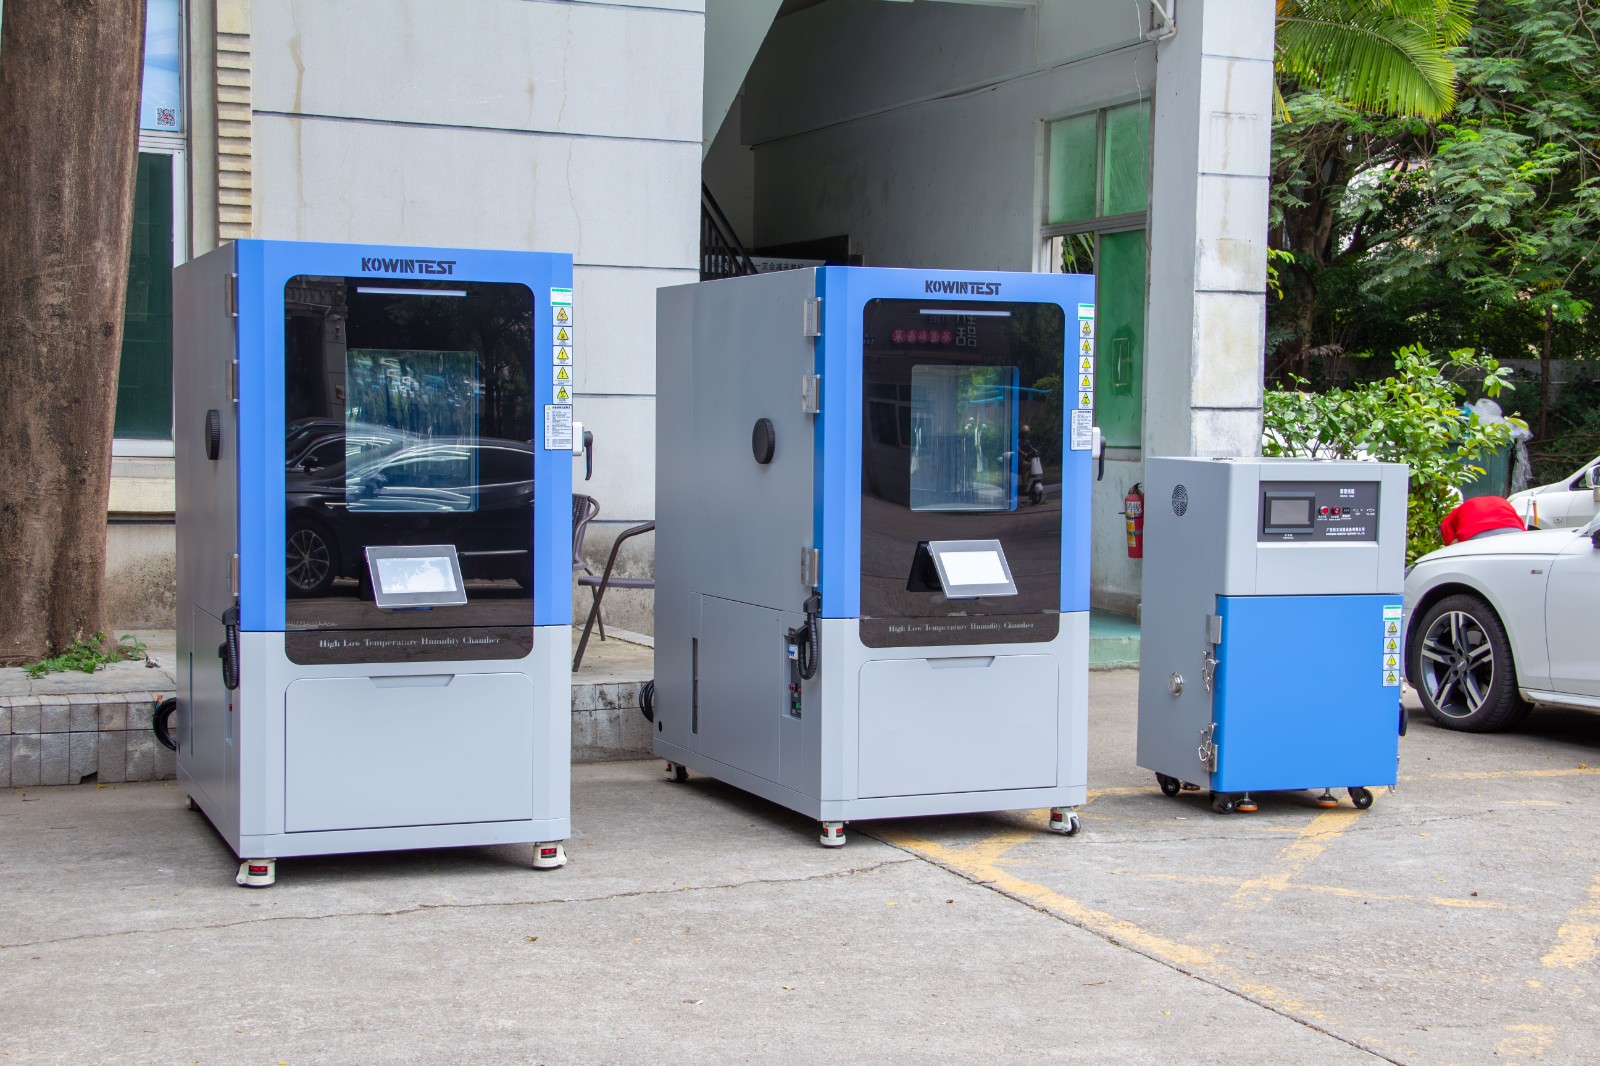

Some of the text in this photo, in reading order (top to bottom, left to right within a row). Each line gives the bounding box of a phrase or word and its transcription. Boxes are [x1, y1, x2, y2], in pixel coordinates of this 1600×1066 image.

[361, 257, 456, 275] KOWINTEST
[925, 280, 1002, 295] KOWINTEST
[888, 624, 905, 633] High
[319, 636, 501, 649] High Low Temperature Humidity Chamber
